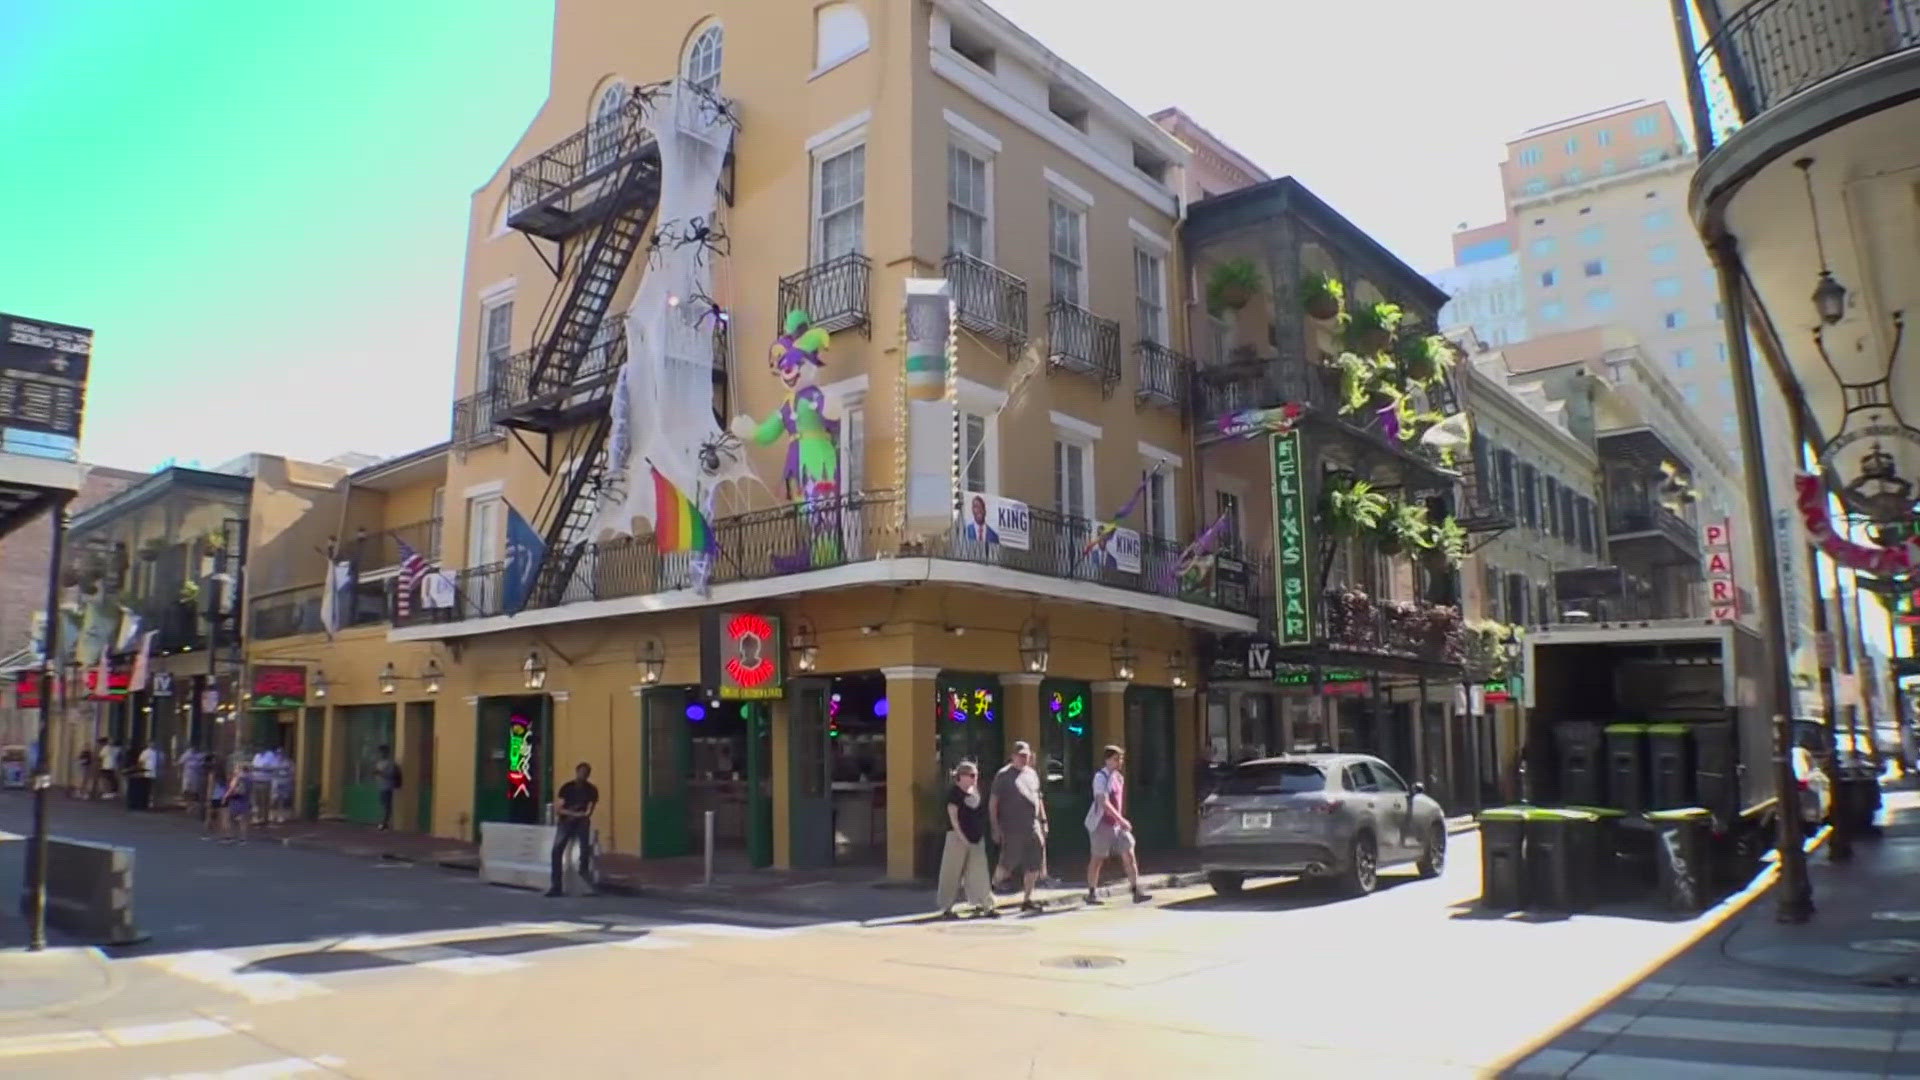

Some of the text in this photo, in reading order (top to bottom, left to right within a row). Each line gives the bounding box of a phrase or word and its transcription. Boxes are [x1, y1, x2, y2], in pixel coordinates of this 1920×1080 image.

[999, 507, 1027, 531] KING
[1117, 534, 1140, 556] KING
[1285, 578, 1304, 635] BAR
[1248, 649, 1270, 670] IV
